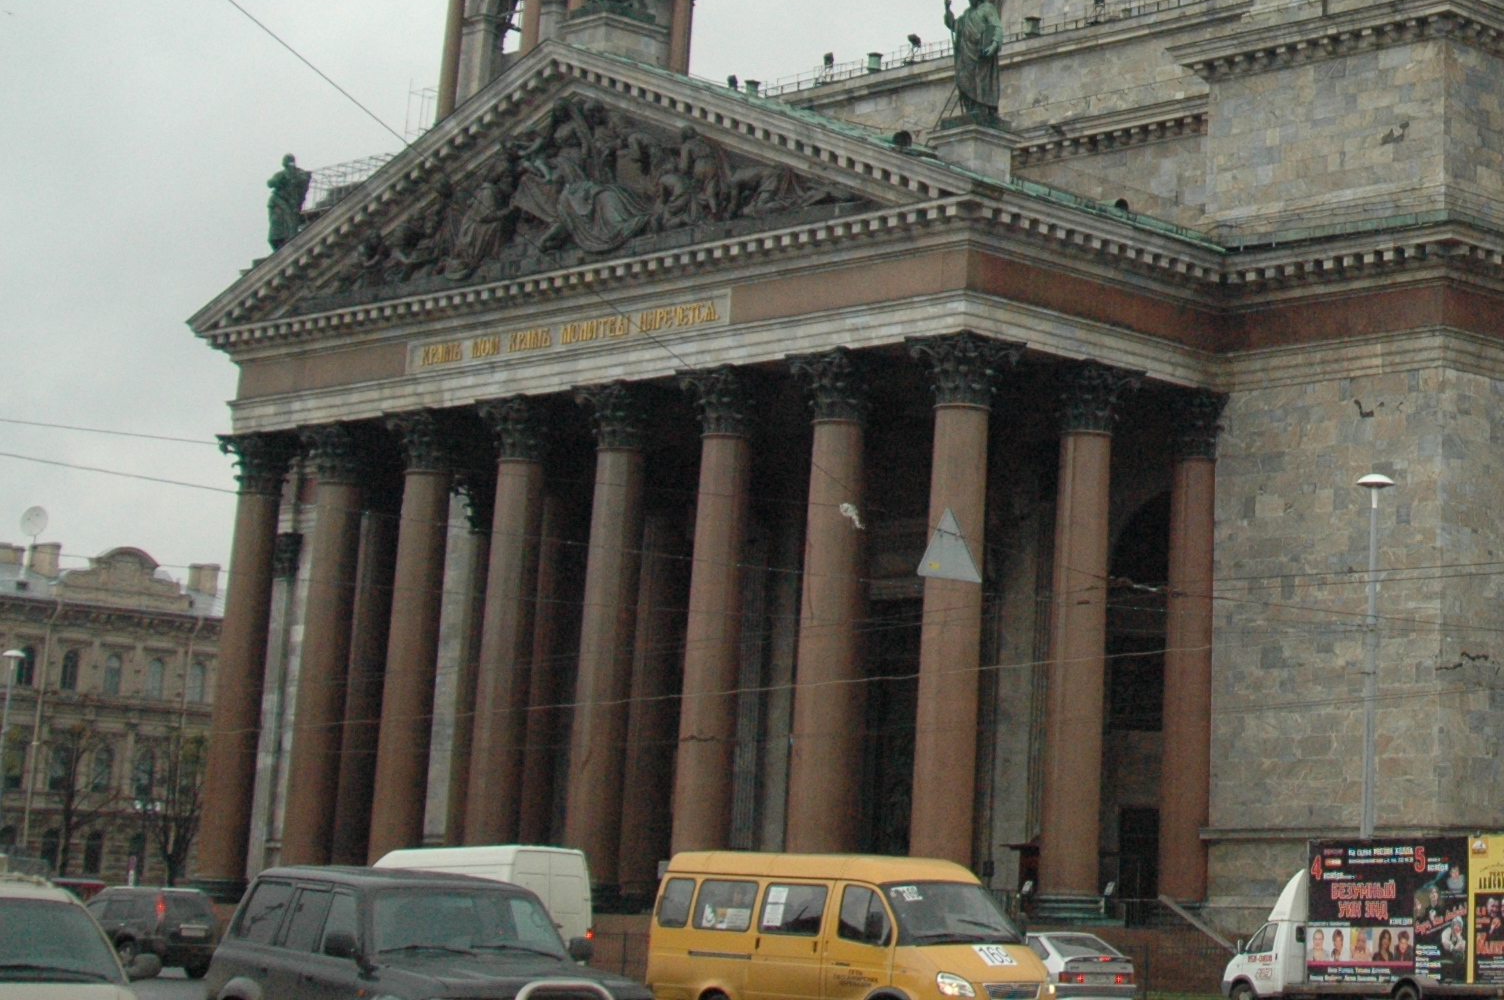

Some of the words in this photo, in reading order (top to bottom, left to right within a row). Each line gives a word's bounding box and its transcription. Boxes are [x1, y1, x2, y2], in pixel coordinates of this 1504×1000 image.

[1310, 855, 1323, 881] 4
[1414, 846, 1426, 872] 5
[1331, 879, 1396, 900] БЕЗУМНЫЙ
[979, 946, 1014, 964] 169
